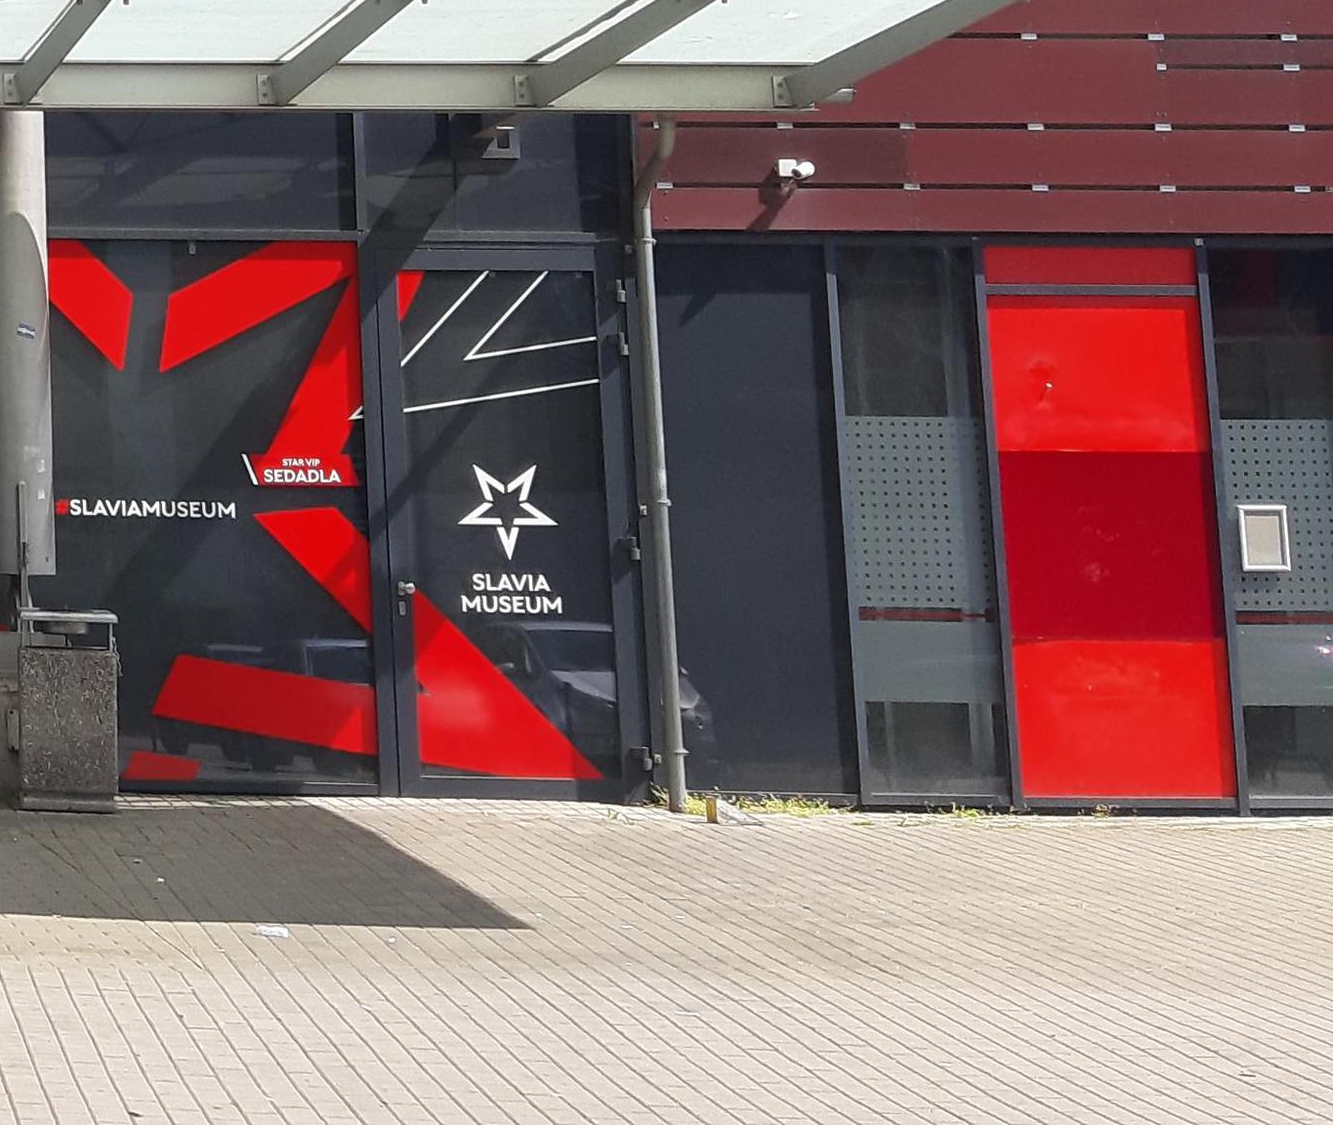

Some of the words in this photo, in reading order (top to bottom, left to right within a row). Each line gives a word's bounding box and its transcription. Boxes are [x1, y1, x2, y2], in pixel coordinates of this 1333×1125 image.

[282, 459, 304, 467] STAR
[305, 459, 321, 467] VIP
[263, 469, 342, 484] SEDADLA
[56, 498, 236, 519] #SLAVIAMUSEUM
[472, 573, 551, 592] SLAVIA
[460, 594, 563, 614] MUSEUM
